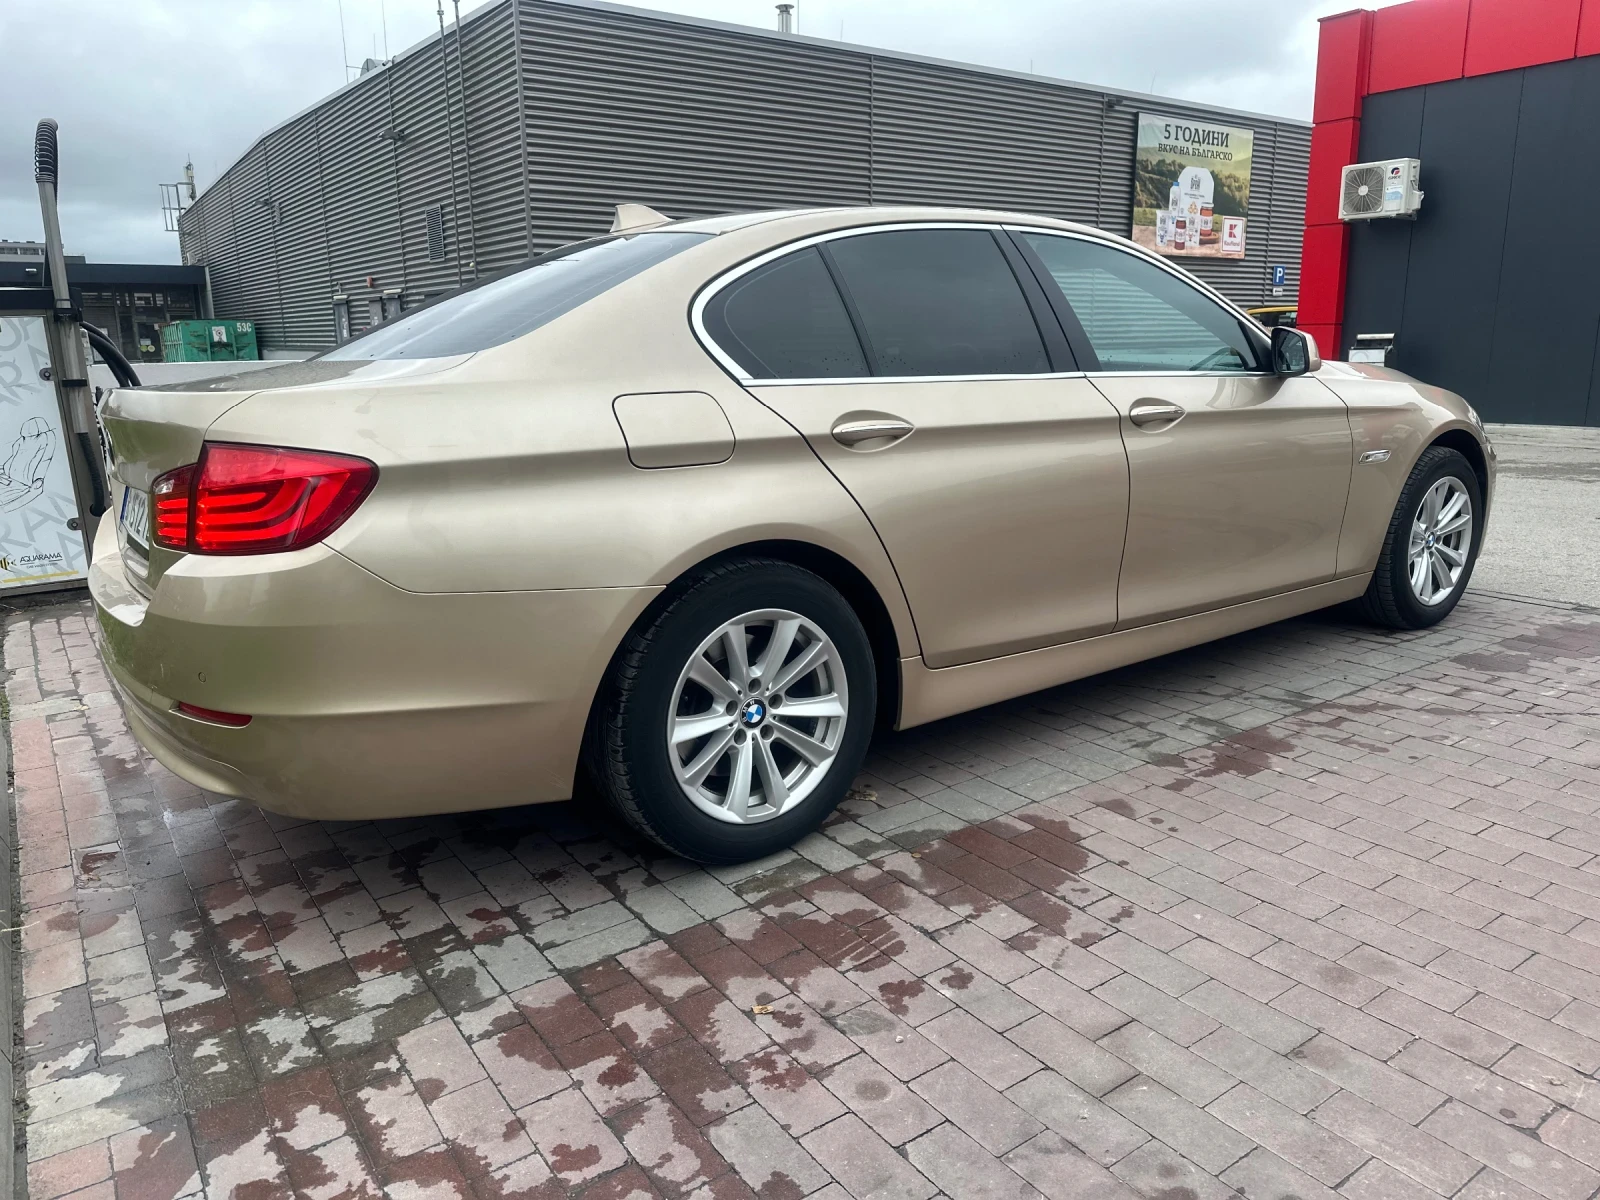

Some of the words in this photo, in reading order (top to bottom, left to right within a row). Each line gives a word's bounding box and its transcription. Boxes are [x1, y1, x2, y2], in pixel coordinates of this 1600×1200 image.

[1164, 123, 1171, 140] 5
[1174, 125, 1229, 148] ГОДИНИ
[1158, 142, 1179, 154] ВКУС
[1179, 147, 1190, 156] НА
[1191, 147, 1233, 161] БЪЛГАРСКО
[1228, 223, 1238, 239] K
[1276, 267, 1284, 283] P
[236, 323, 252, 332] 53C
[19, 552, 63, 563] AQUARAMA
